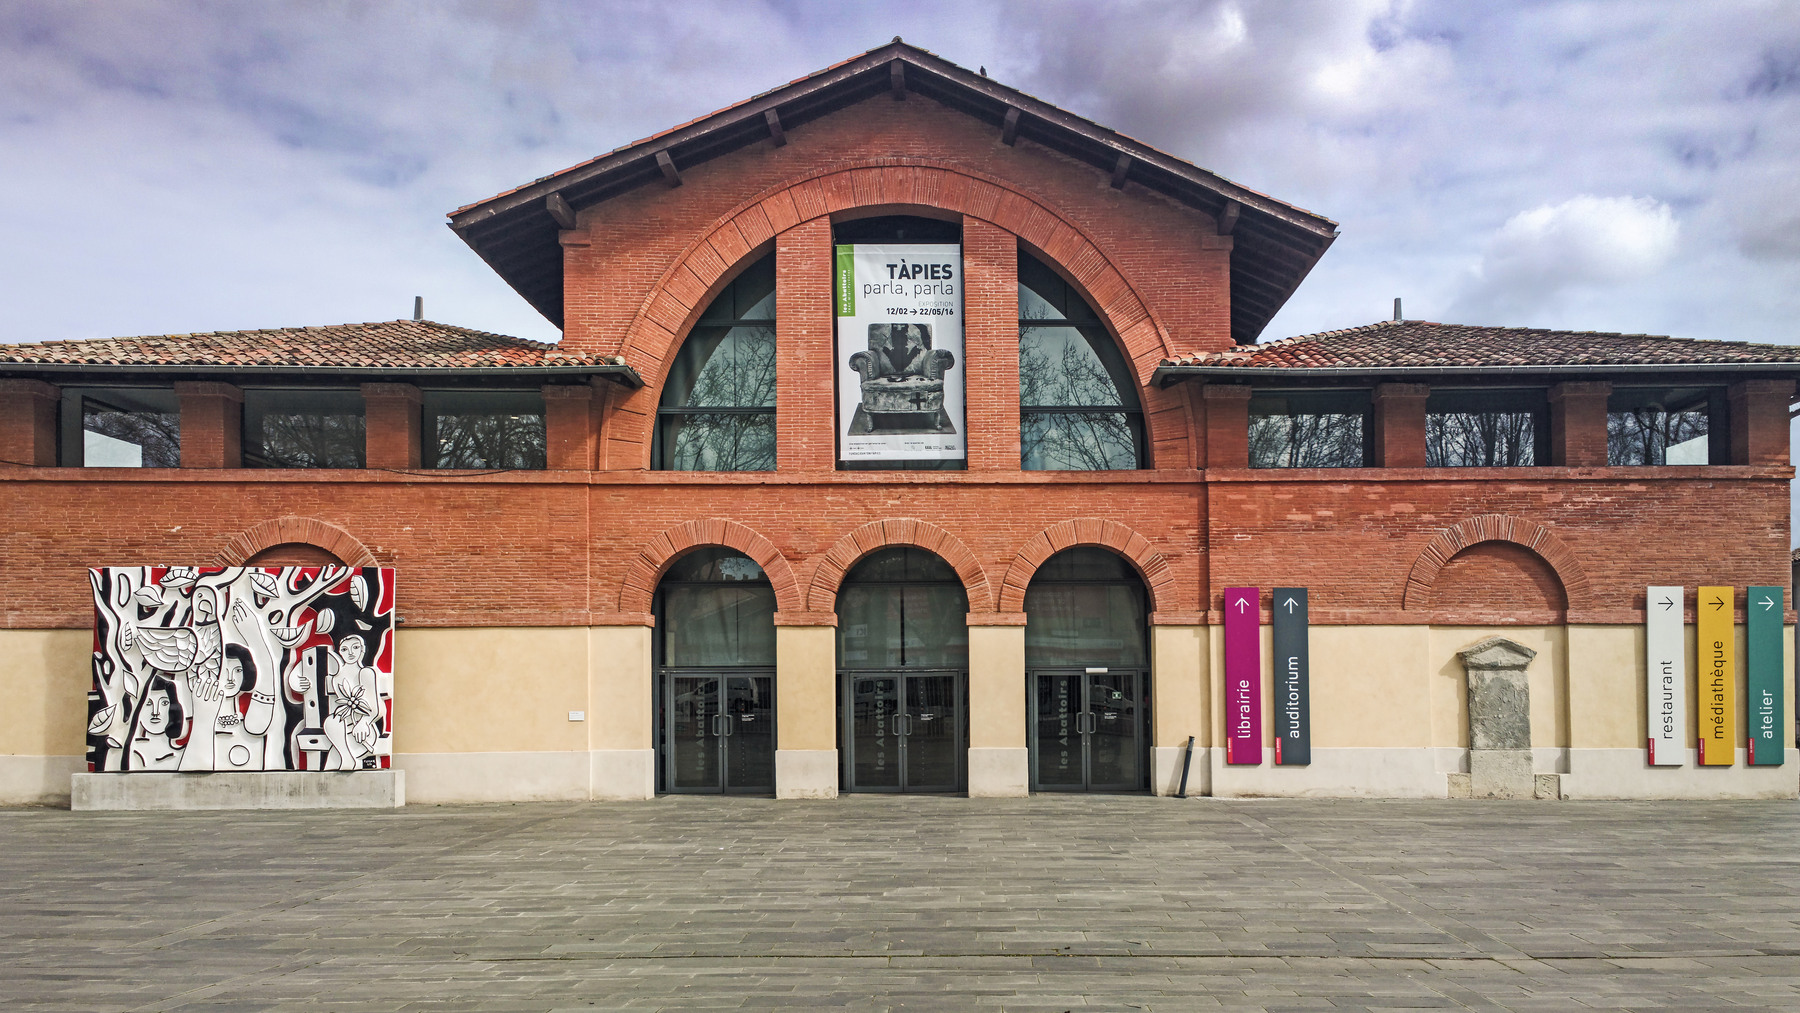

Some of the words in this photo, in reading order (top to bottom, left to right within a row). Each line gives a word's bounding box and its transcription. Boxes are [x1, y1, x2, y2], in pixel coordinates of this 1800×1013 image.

[863, 280, 908, 298] parla,
[914, 280, 954, 298] parla
[886, 259, 953, 280] TÀPIES
[919, 308, 954, 316] 22/05/16
[874, 680, 885, 747] Abattoirs
[1058, 680, 1068, 746] Abattoirs
[1237, 679, 1250, 739] librairie
[1285, 656, 1300, 739] auditorium
[1660, 660, 1673, 739] restaurant
[1710, 640, 1727, 739] médiathèque
[1759, 689, 1773, 739] atelier
[875, 752, 885, 771] les
[1059, 750, 1068, 769] les
